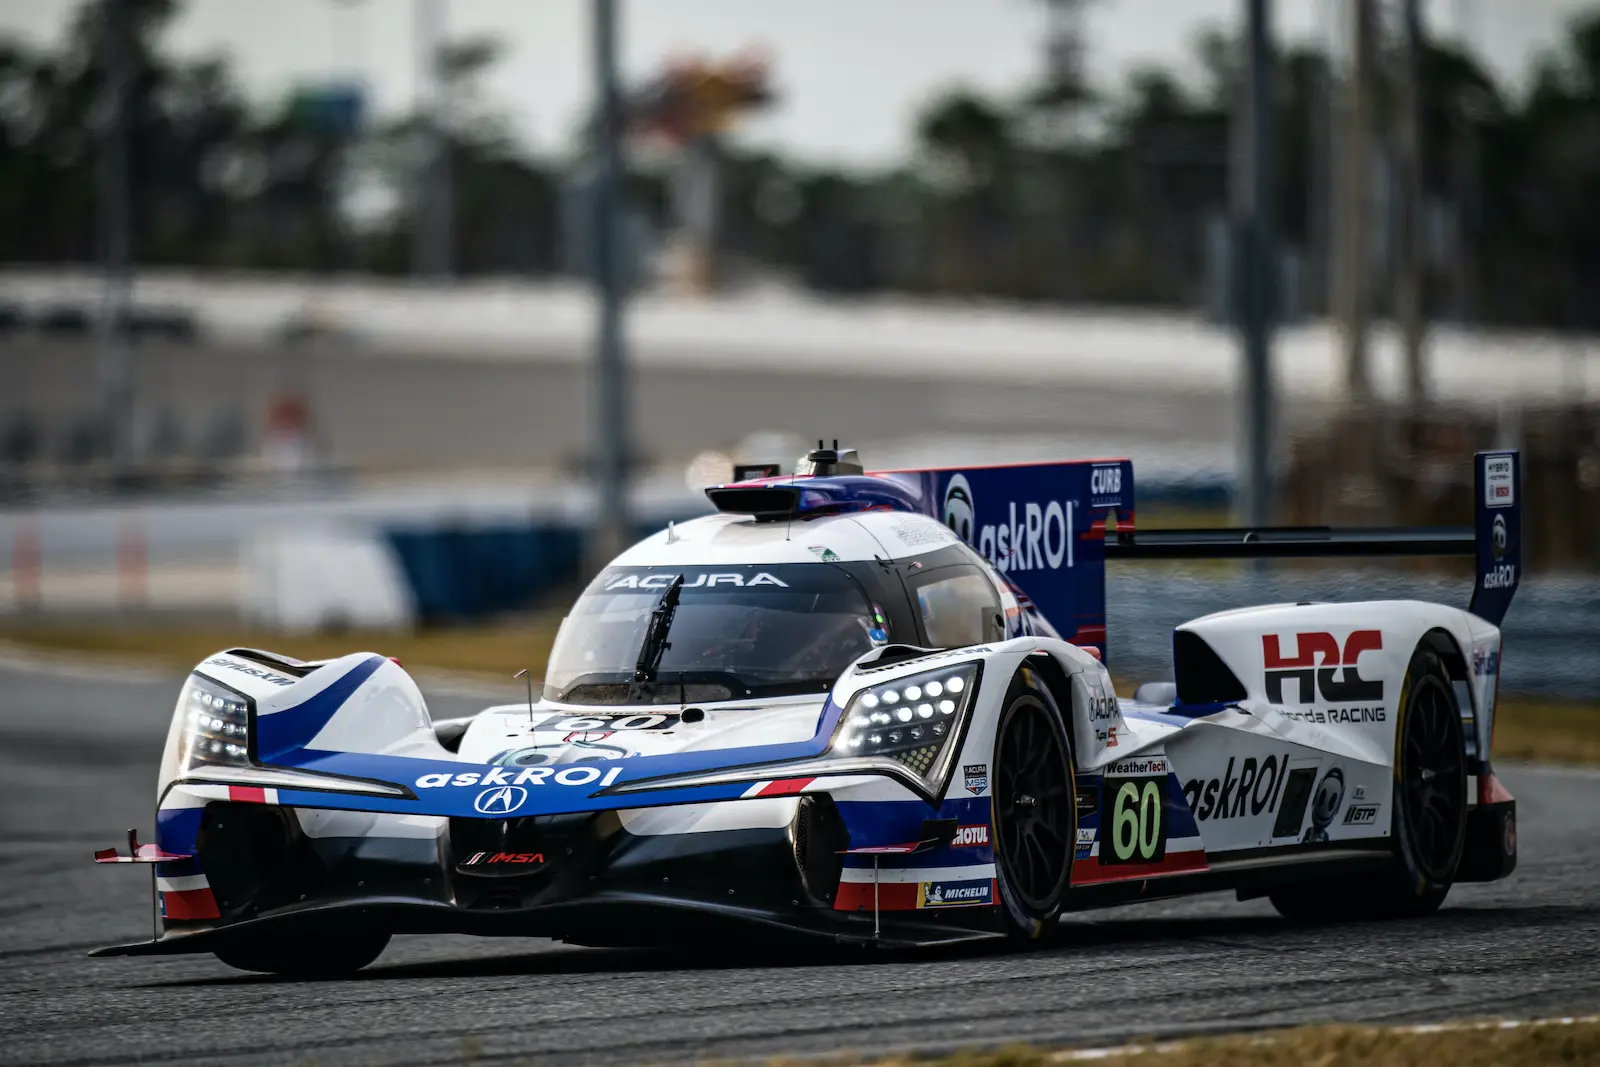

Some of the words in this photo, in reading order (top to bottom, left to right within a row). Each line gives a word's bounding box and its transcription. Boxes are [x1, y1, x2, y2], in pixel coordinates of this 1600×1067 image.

[1091, 468, 1122, 495] CURB
[979, 500, 1074, 573] askROI
[605, 572, 790, 591] ACURA
[1484, 565, 1515, 589] askROI
[1262, 630, 1384, 704] HRC
[555, 714, 668, 731] 60
[1328, 707, 1386, 723] RACING
[1106, 728, 1118, 747] S
[1107, 760, 1166, 774] WeatherTech
[415, 767, 623, 788] askROI
[966, 778, 987, 787] MSR
[1184, 754, 1289, 821] askROI
[1112, 781, 1161, 860] 60
[1354, 808, 1377, 820] GTP
[952, 826, 989, 845] MOTUL
[487, 852, 545, 863] IMSA
[945, 886, 989, 899] MICHELIN
